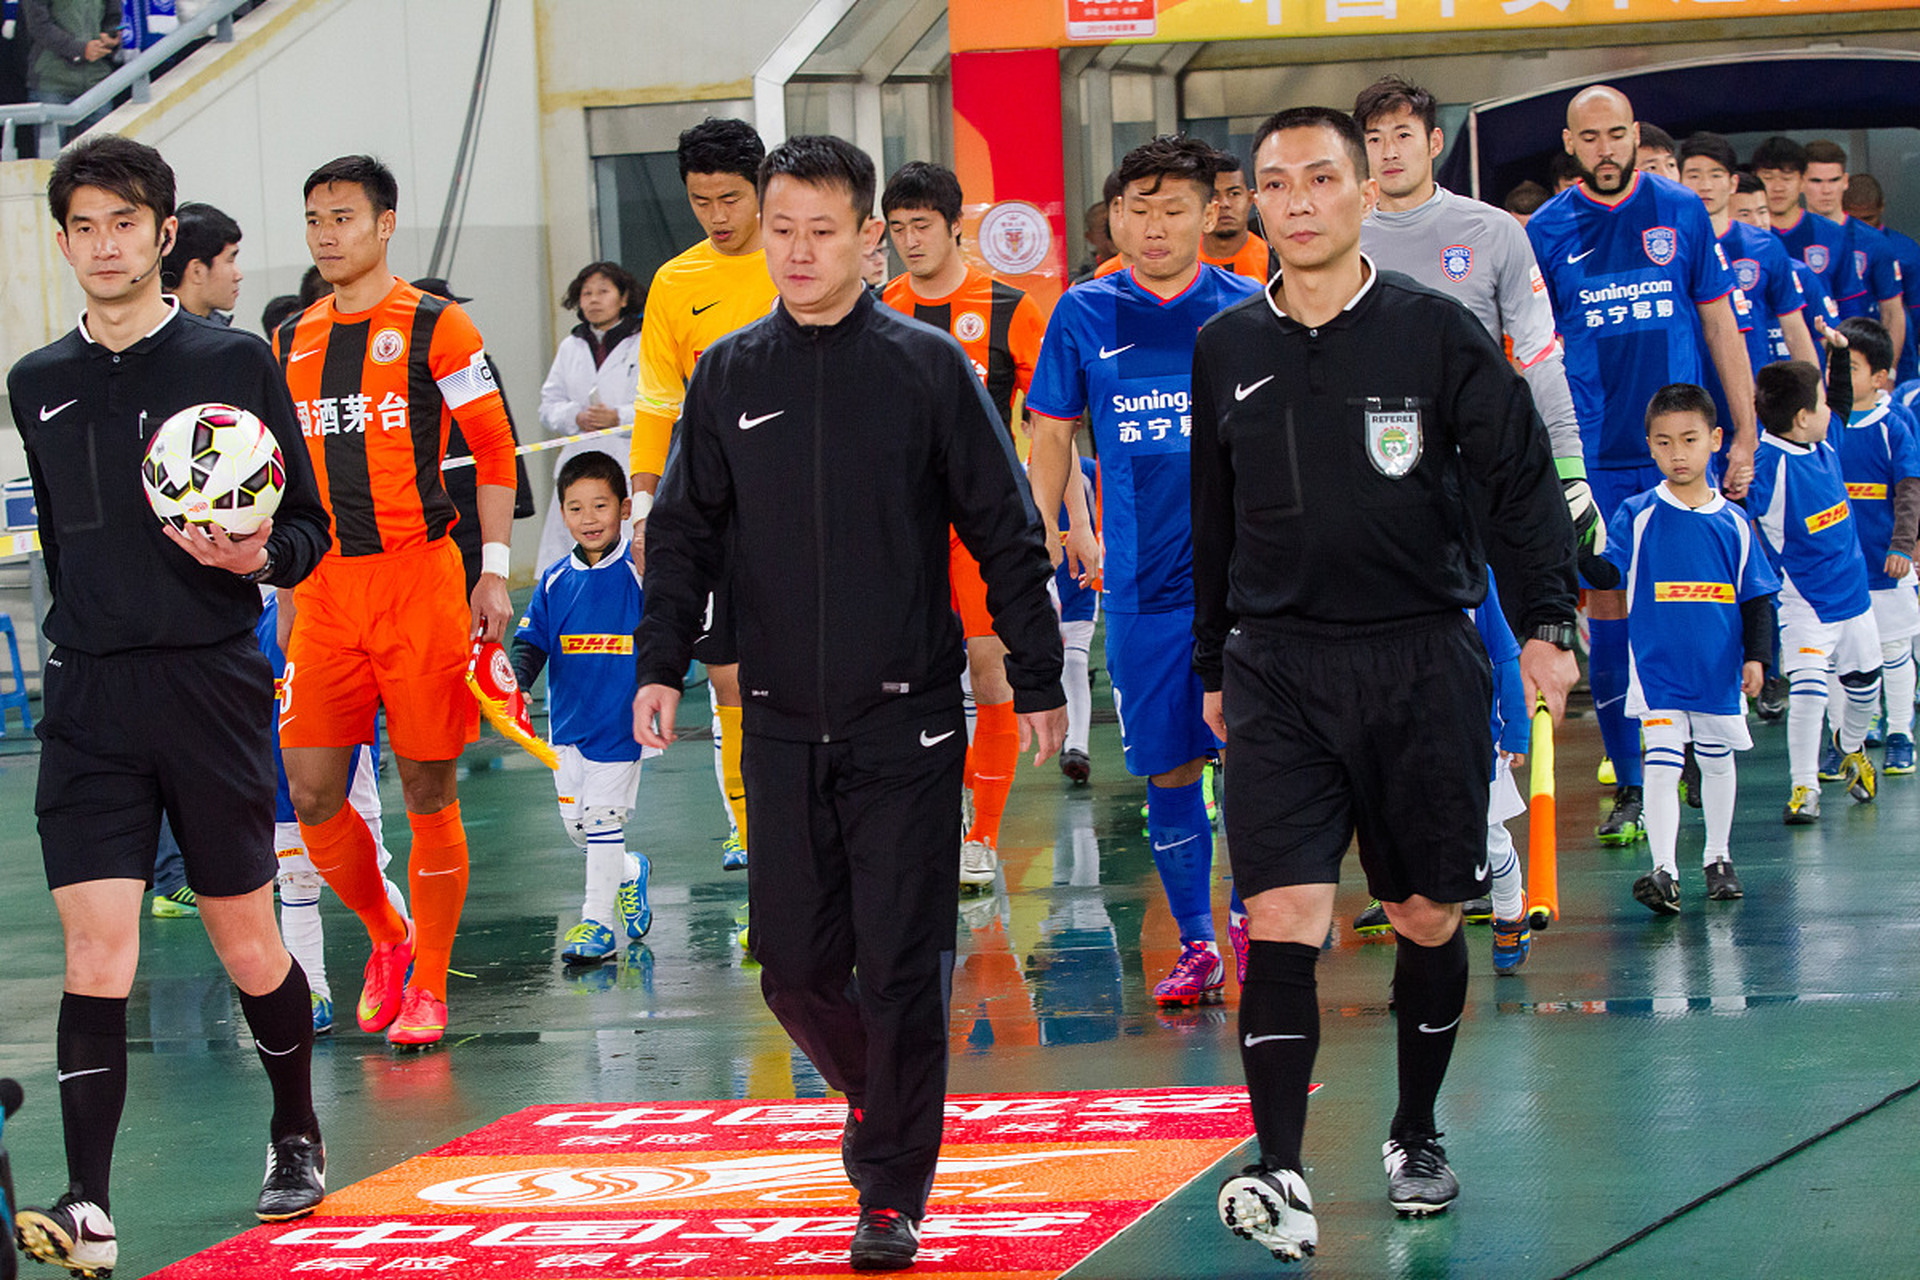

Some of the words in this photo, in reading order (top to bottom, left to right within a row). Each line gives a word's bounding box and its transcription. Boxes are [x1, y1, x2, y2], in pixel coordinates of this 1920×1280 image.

[1579, 280, 1672, 304] Suning.com
[1371, 415, 1415, 424] REFEREE
[1667, 585, 1725, 599] DHL
[567, 637, 622, 651] DHL
